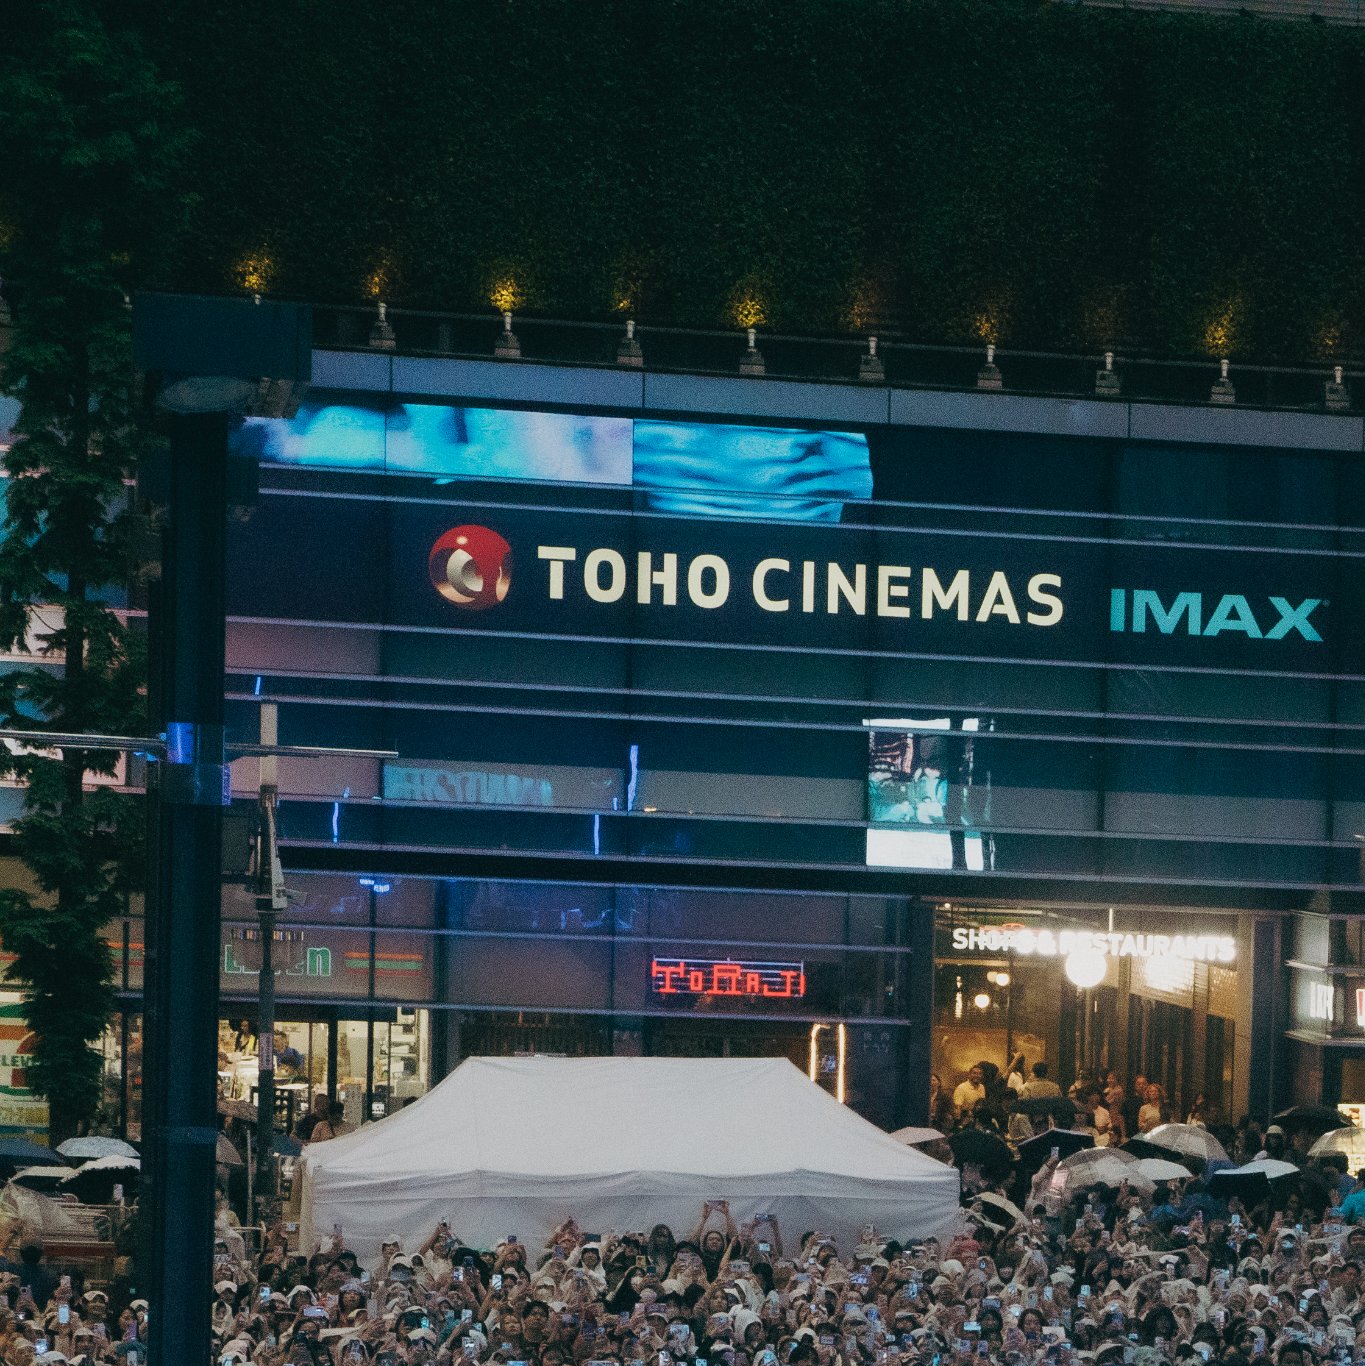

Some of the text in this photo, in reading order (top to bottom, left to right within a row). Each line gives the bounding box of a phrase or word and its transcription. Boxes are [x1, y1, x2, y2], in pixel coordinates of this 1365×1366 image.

[537, 545, 1064, 628] TOHO CINEMAS
[1111, 587, 1324, 644] IMAX
[1059, 931, 1236, 962] RESTAURANTS
